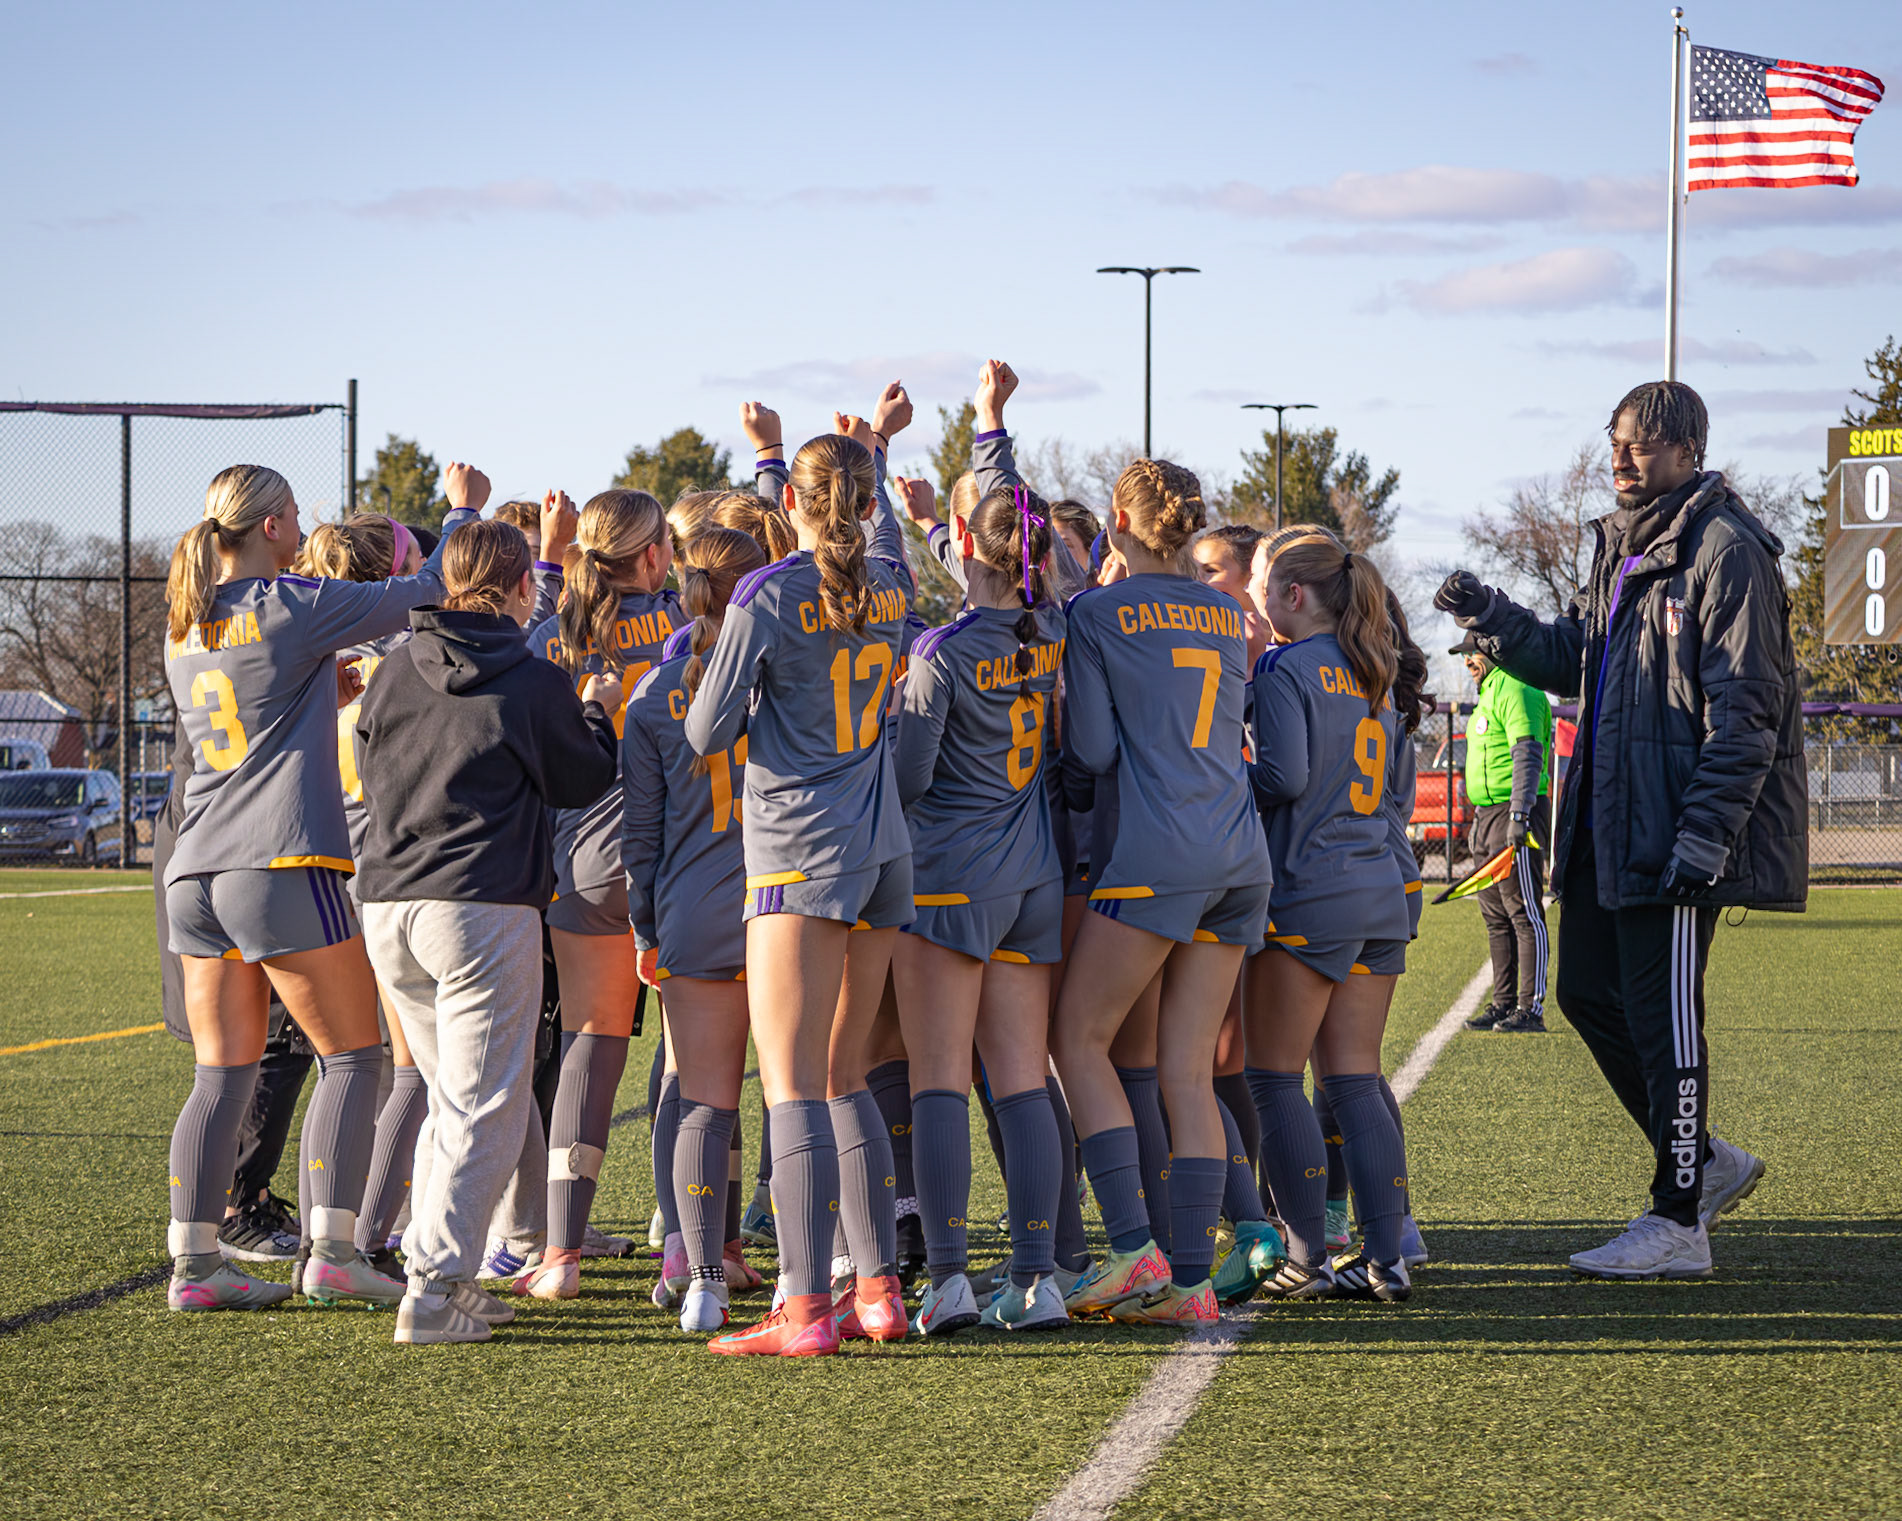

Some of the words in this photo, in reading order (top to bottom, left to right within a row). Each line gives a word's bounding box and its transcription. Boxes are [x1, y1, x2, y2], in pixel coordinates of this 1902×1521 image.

[1849, 429, 1902, 456] SCOTS
[1864, 465, 1890, 521] 0
[1865, 547, 1886, 590] 0
[1117, 602, 1244, 641] CALEDONIA
[1865, 593, 1886, 636] 0
[191, 669, 249, 772] 3
[830, 642, 892, 754] 12
[1171, 648, 1222, 748] 7
[1007, 691, 1044, 792] 8
[1349, 717, 1387, 816] 9
[1671, 1077, 1698, 1189] adidas
[687, 1183, 714, 1197] CA
[1304, 1165, 1326, 1179] CA
[1026, 1219, 1050, 1231] CA
